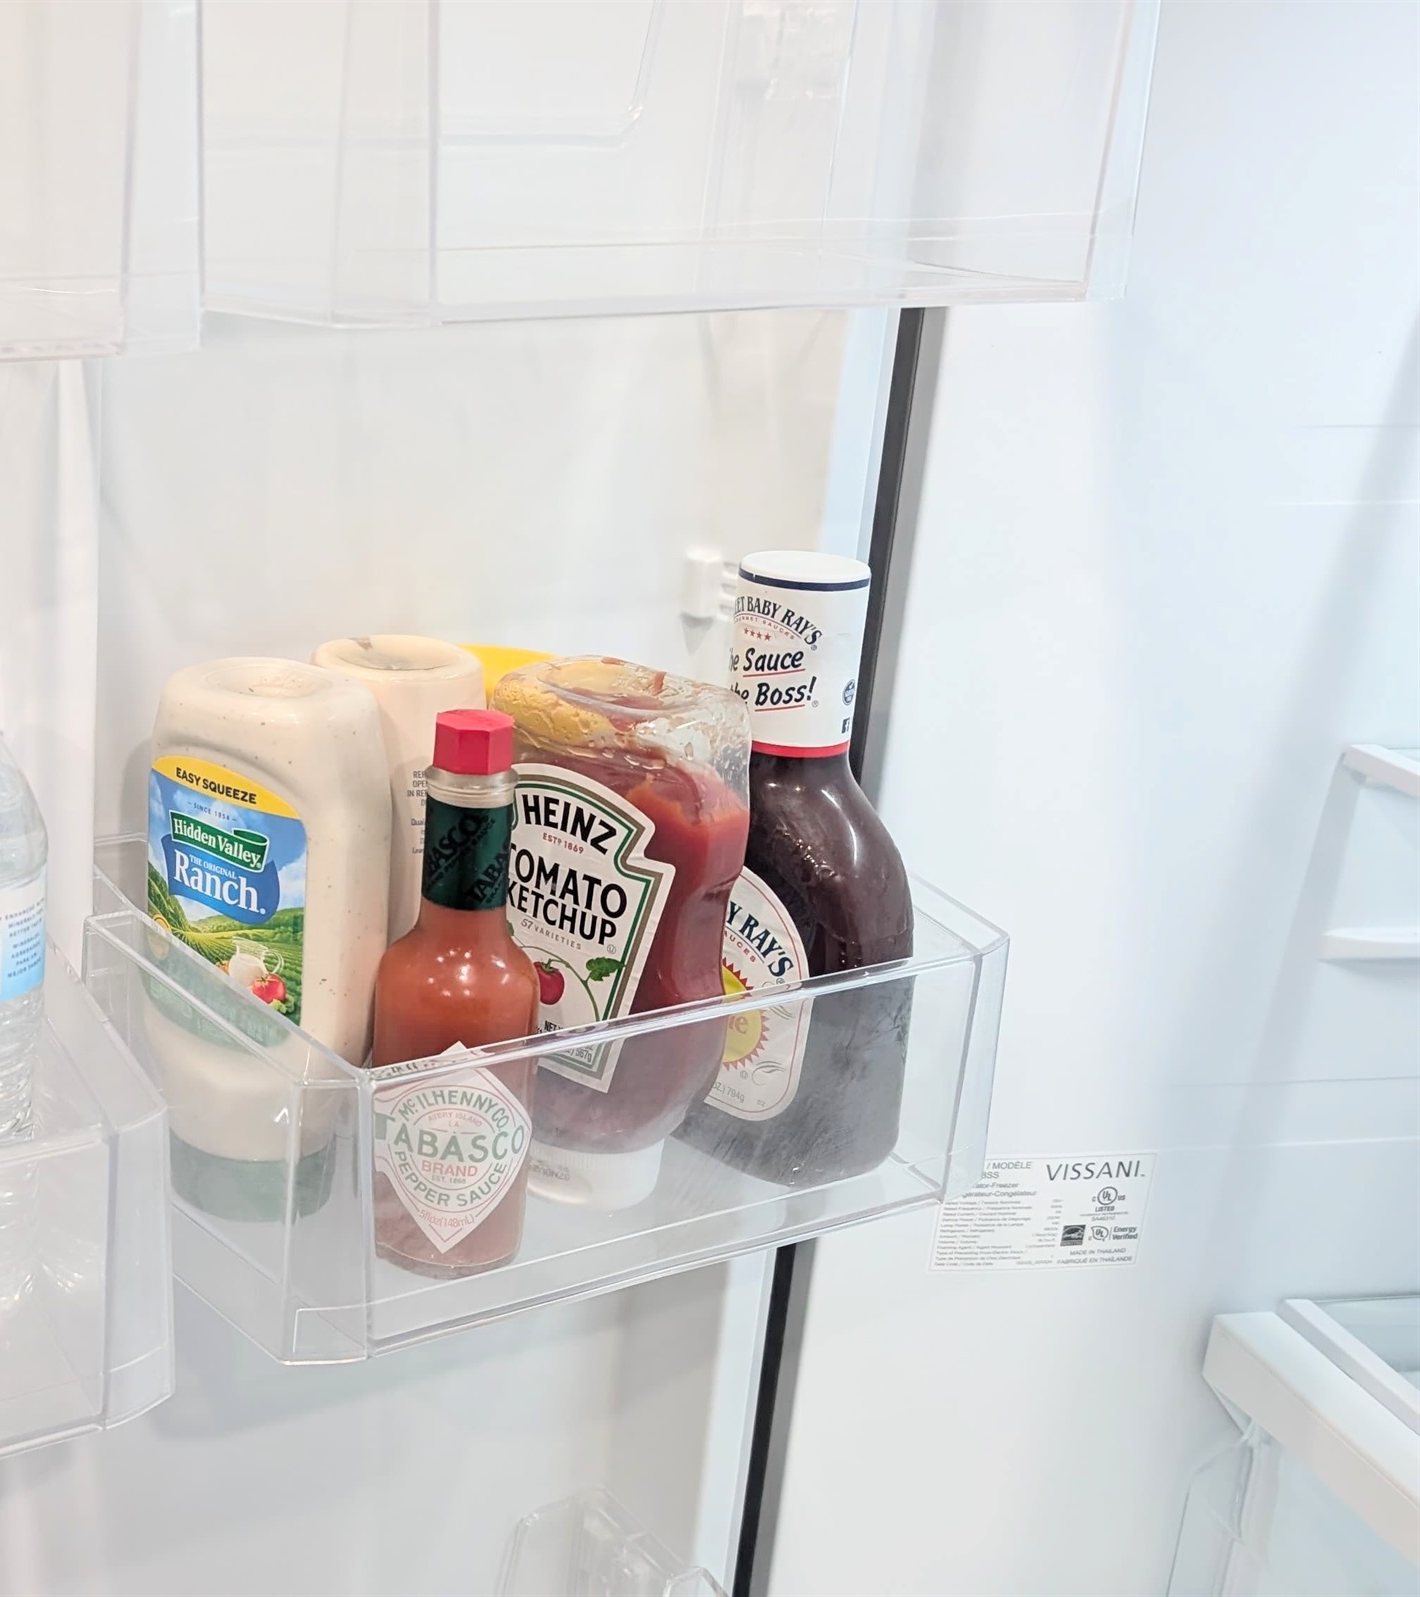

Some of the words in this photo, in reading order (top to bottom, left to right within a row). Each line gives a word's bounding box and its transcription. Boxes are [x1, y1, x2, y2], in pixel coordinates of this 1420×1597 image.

[747, 597, 782, 619] BABY
[780, 609, 823, 646] RAY'S
[762, 620, 795, 640] SAUCES
[743, 647, 805, 672] Sauce
[754, 676, 818, 706] Boss!
[176, 767, 201, 786] EASY
[202, 780, 257, 804] SQUEEZE
[193, 802, 212, 815] SINCE
[522, 794, 617, 855] HEINZ
[174, 818, 216, 848] Hidden
[217, 834, 261, 868] Valley
[564, 840, 584, 855] 1869
[189, 854, 202, 866] THE
[203, 861, 238, 880] ORIGINAL
[511, 842, 628, 918] OMATO
[507, 879, 617, 945] KETCHUP
[521, 918, 534, 930] 57
[534, 924, 582, 950] VARIETIES
[739, 913, 794, 978] RAY'S
[428, 1111, 453, 1121] AVERY
[455, 1112, 483, 1127] ISLAND
[374, 1111, 525, 1163] TABASCO
[395, 1150, 450, 1207] PEPPER
[457, 1162, 508, 1208] SAUCE
[421, 1160, 478, 1177] BRAND
[992, 1160, 1032, 1170] MODÈLE
[1046, 1160, 1140, 1181] VISSANI
[962, 1190, 1037, 1199] gérateur-Congélateur
[1095, 1205, 1115, 1213] LISTED
[1112, 1233, 1138, 1241] Verified
[1113, 1226, 1137, 1234] Energy
